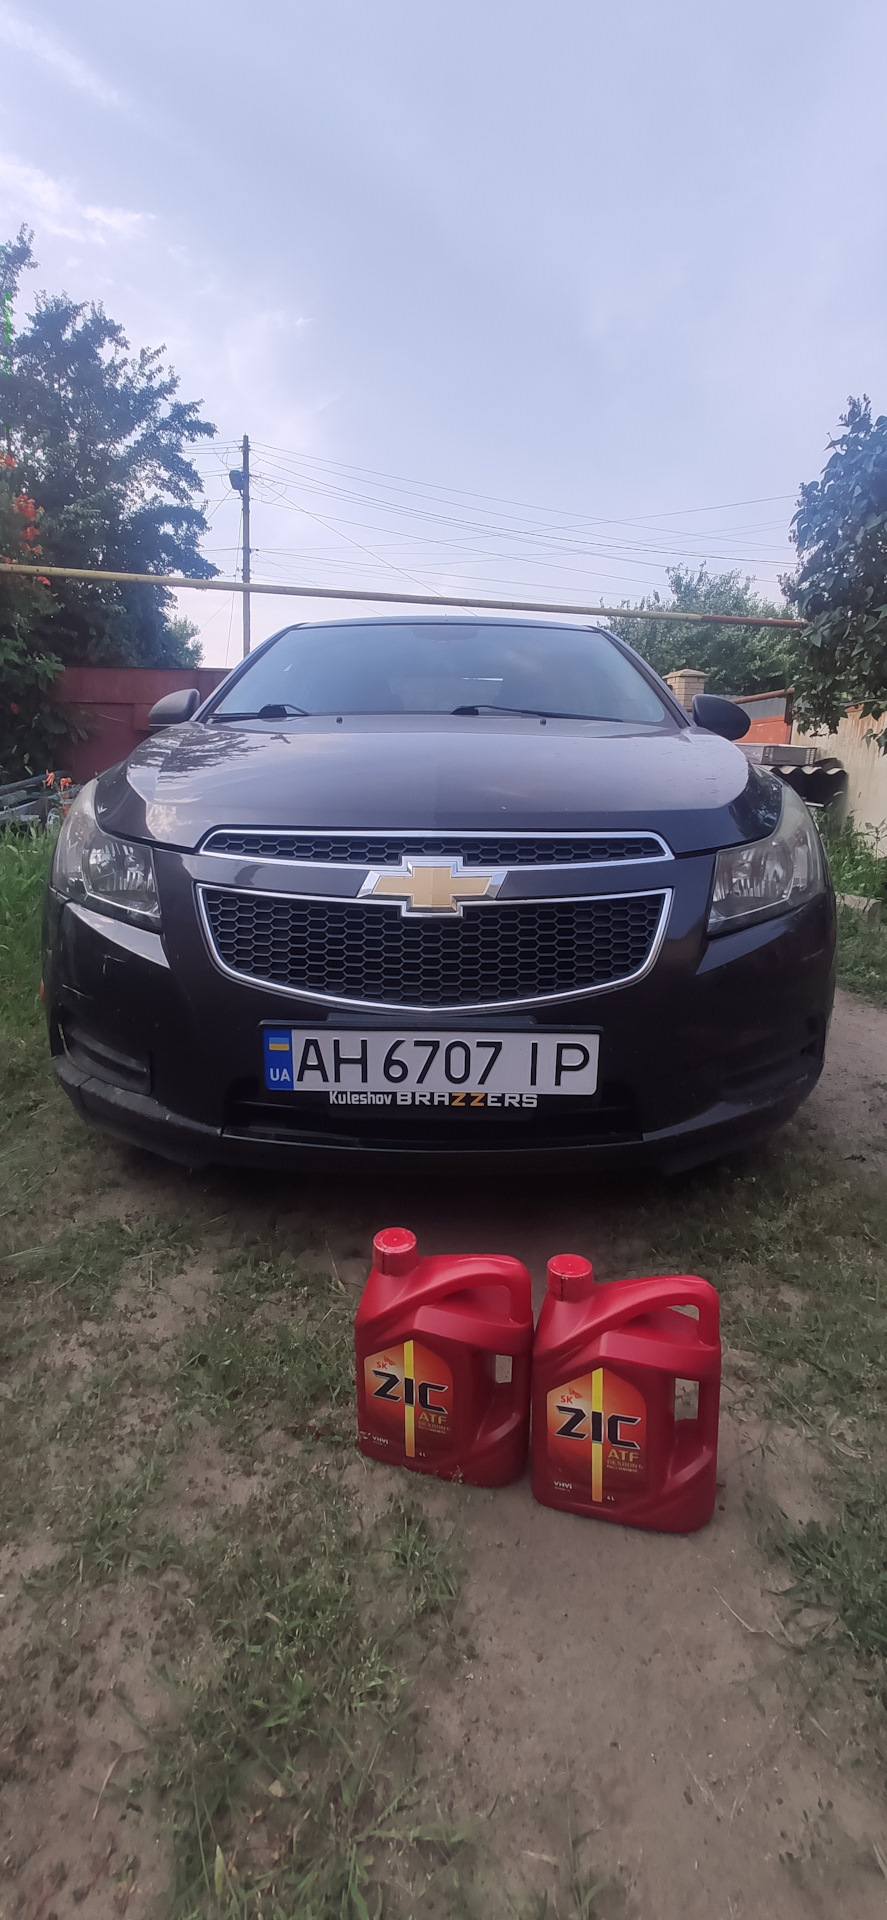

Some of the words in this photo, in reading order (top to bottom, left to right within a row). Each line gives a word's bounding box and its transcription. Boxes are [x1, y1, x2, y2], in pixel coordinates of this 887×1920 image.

[296, 1038, 368, 1083] AH
[383, 1039, 503, 1086] 6707
[269, 1067, 292, 1082] UA
[329, 1090, 393, 1106] Kuleshov
[396, 1091, 538, 1108] BRAZZERS
[376, 1361, 388, 1369] SK
[371, 1369, 449, 1415] ZIC
[560, 1395, 573, 1404] SK
[418, 1411, 448, 1425] ATF
[554, 1404, 642, 1450] ZIC
[607, 1448, 640, 1462] ATF
